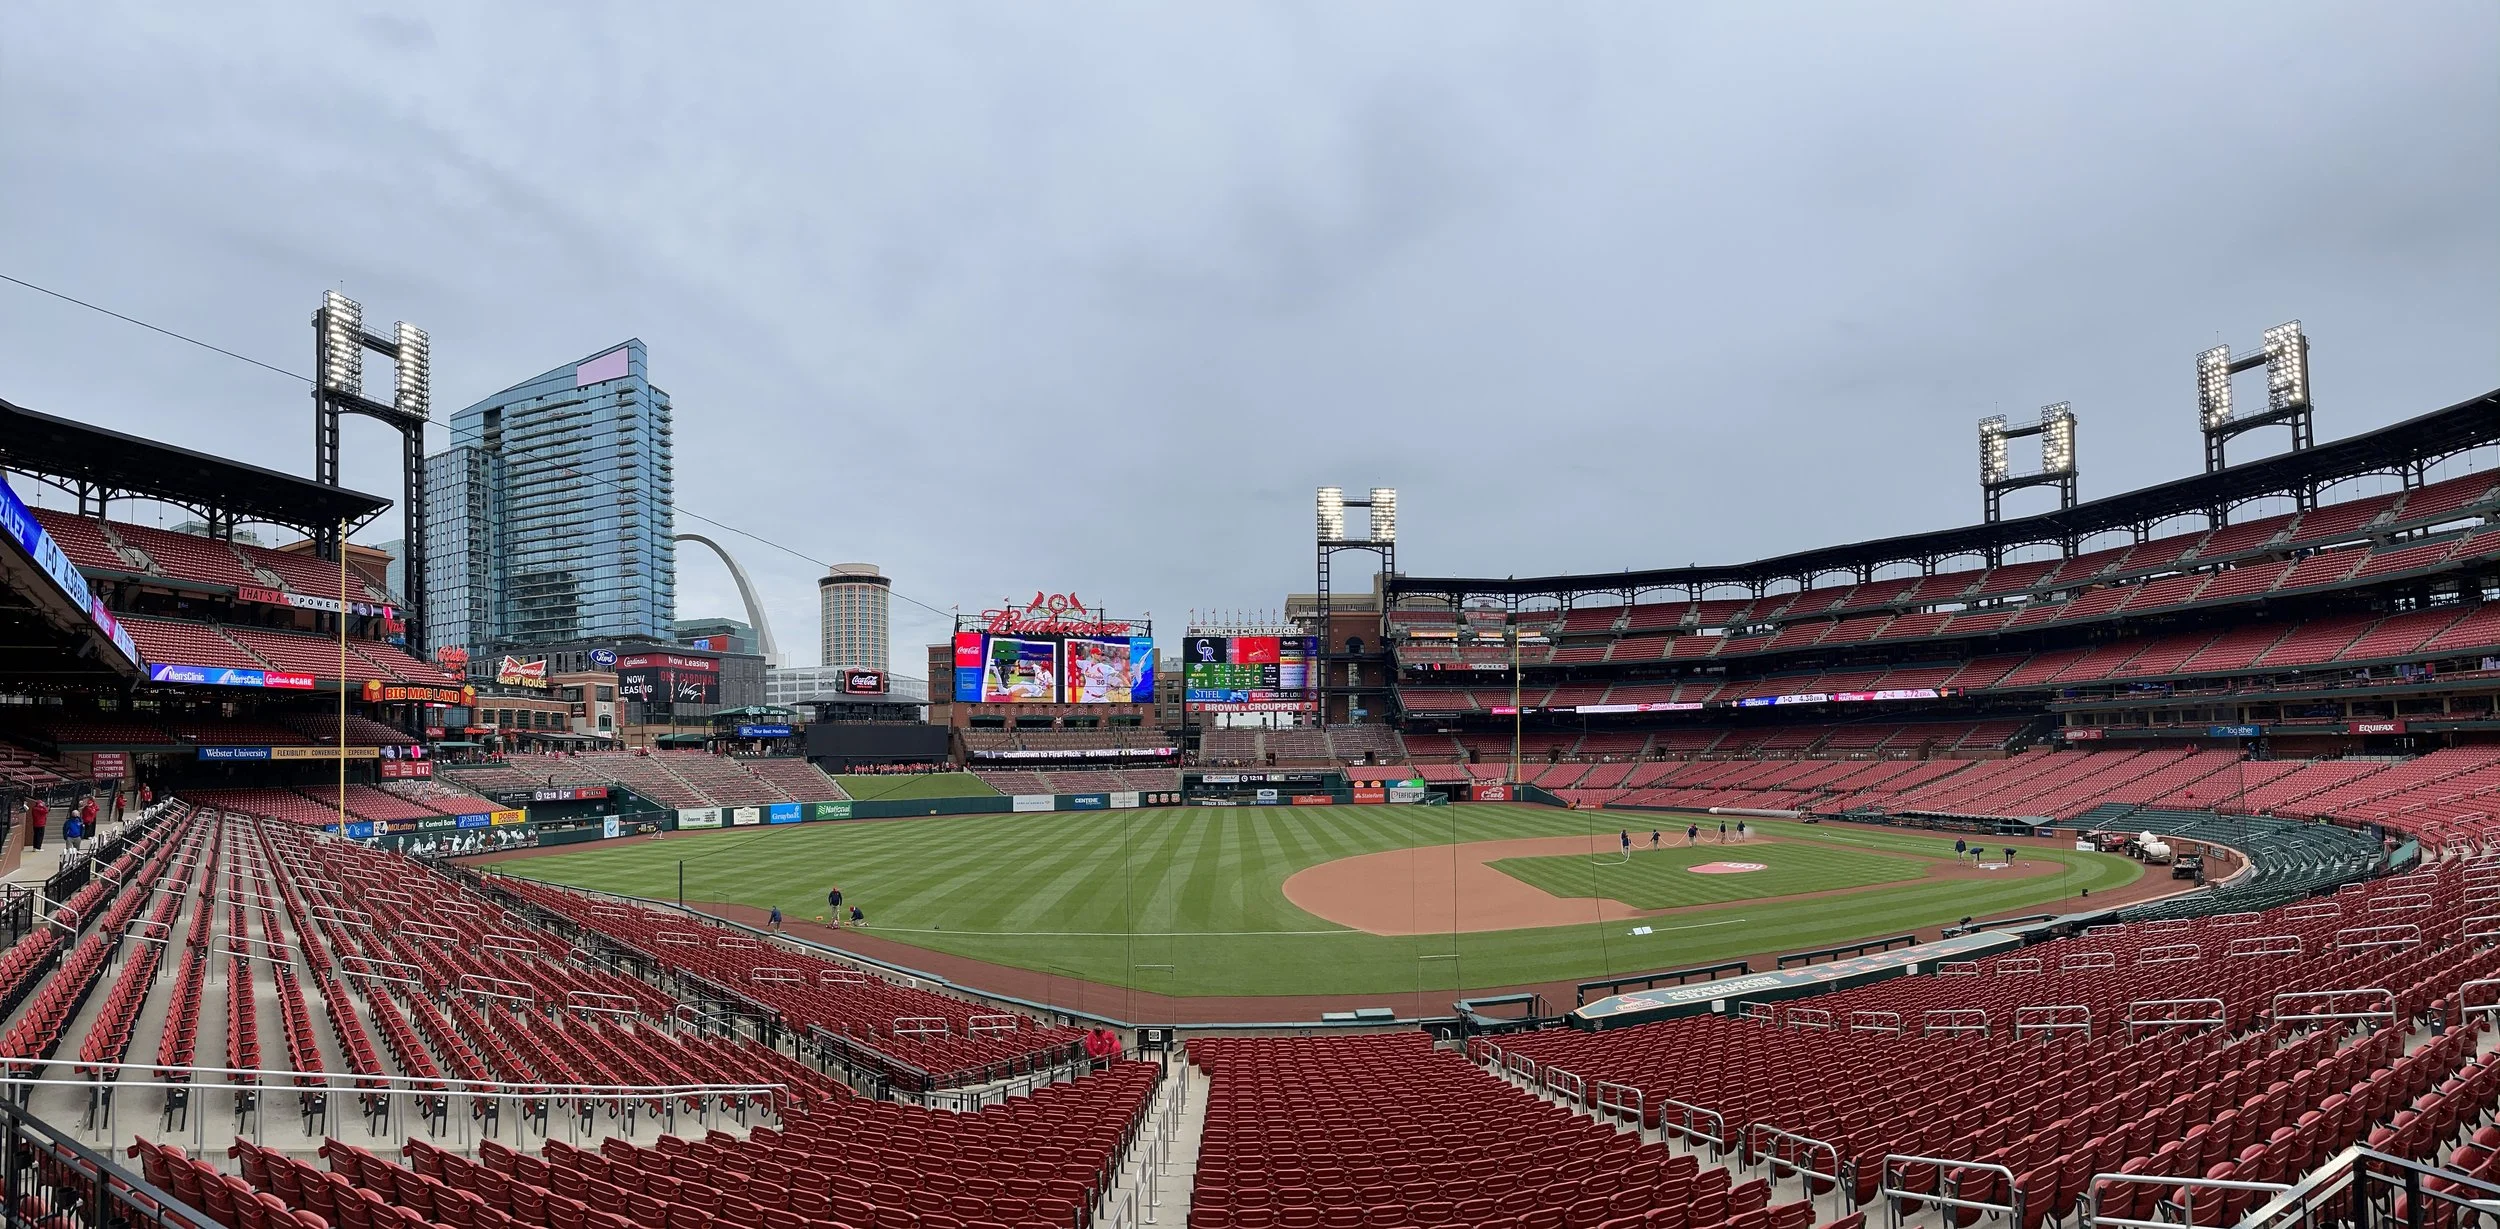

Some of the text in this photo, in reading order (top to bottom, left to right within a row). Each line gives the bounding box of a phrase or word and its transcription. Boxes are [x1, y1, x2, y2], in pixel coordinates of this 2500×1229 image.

[241, 587, 340, 609] THAT'S A POWER
[982, 609, 1131, 635] Budweiser
[1199, 627, 1304, 636] WORLD CHAMPIONS
[957, 646, 980, 655] Coca-Cola
[597, 650, 613, 663] Ford
[623, 657, 648, 668] Cardinals
[668, 656, 710, 670] Now Leasing
[265, 674, 290, 685] Cardinals
[499, 675, 548, 689] BREW HOUSE
[626, 675, 645, 685] NOW
[679, 672, 717, 686] CARDINAL
[851, 675, 878, 686] Coca-Cola
[620, 685, 654, 695] LEASING
[1882, 691, 1895, 699] 2-4
[1903, 690, 1919, 698] 3.72
[385, 687, 460, 704] BIG MAC LAND
[1204, 703, 1240, 712] BROWN
[1247, 703, 1301, 711] CROUPPEN
[2226, 726, 2254, 736] Together
[2358, 724, 2395, 734] EQUIFAX
[205, 748, 268, 759] Webster University
[276, 749, 308, 757] FLEXIBILITY
[311, 749, 344, 757] CONVENIENC
[1064, 750, 1082, 758] Pitch:
[1095, 749, 1120, 757] Minutes
[1130, 748, 1155, 756] Seconds
[416, 766, 430, 775] 042
[543, 790, 557, 800] 12:18
[825, 804, 851, 814] National
[498, 811, 520, 821] DOBBS
[387, 822, 417, 833] MOLottery
[425, 818, 457, 829] Central Bank
[1671, 979, 1782, 1001] CHAMPIONS
